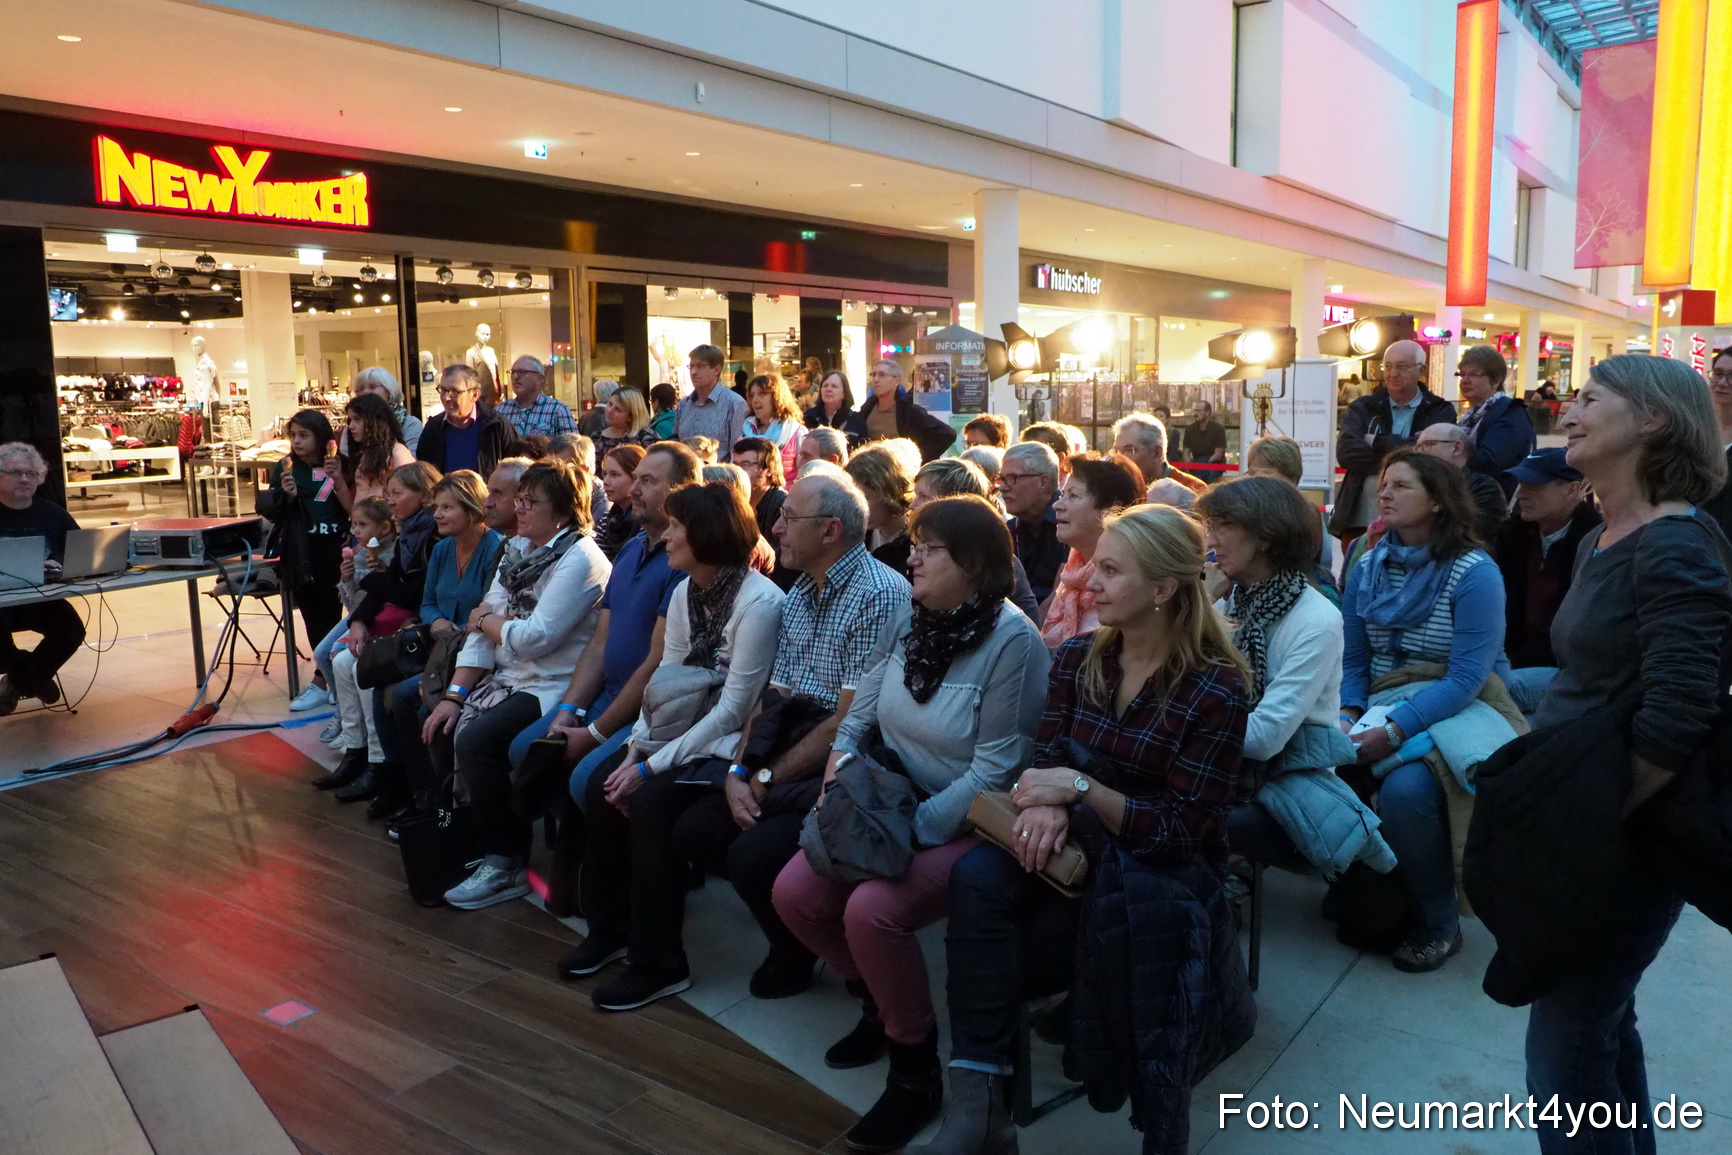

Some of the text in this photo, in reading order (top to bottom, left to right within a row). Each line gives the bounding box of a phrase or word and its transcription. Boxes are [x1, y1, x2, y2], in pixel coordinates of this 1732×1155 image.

[1051, 266, 1102, 295] hübscher
[935, 341, 986, 351] INFORMATI
[312, 467, 335, 502] 7
